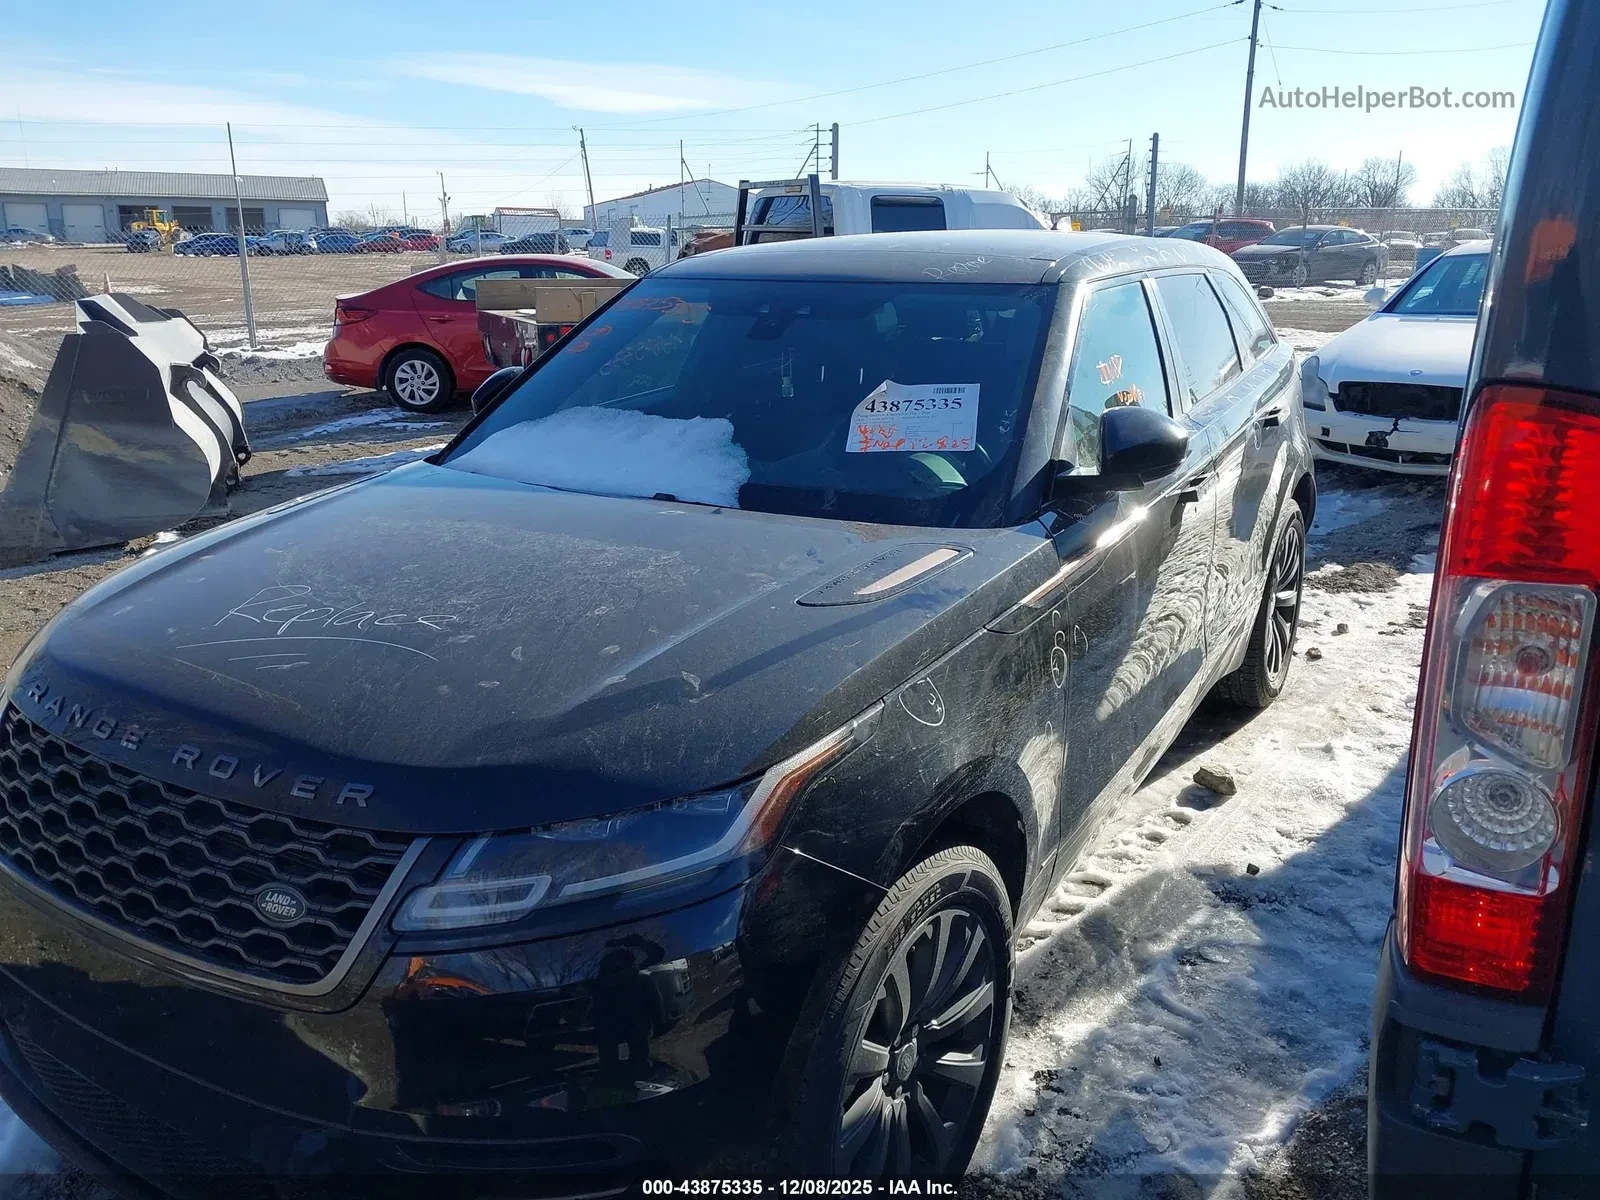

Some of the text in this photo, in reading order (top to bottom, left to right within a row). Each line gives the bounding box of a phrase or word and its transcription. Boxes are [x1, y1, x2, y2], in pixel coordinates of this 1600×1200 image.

[865, 397, 963, 413] 43875335
[214, 584, 457, 635] Replace
[27, 683, 374, 808] RANGE ROVER
[265, 891, 291, 905] LAND
[265, 902, 296, 917] ROVER
